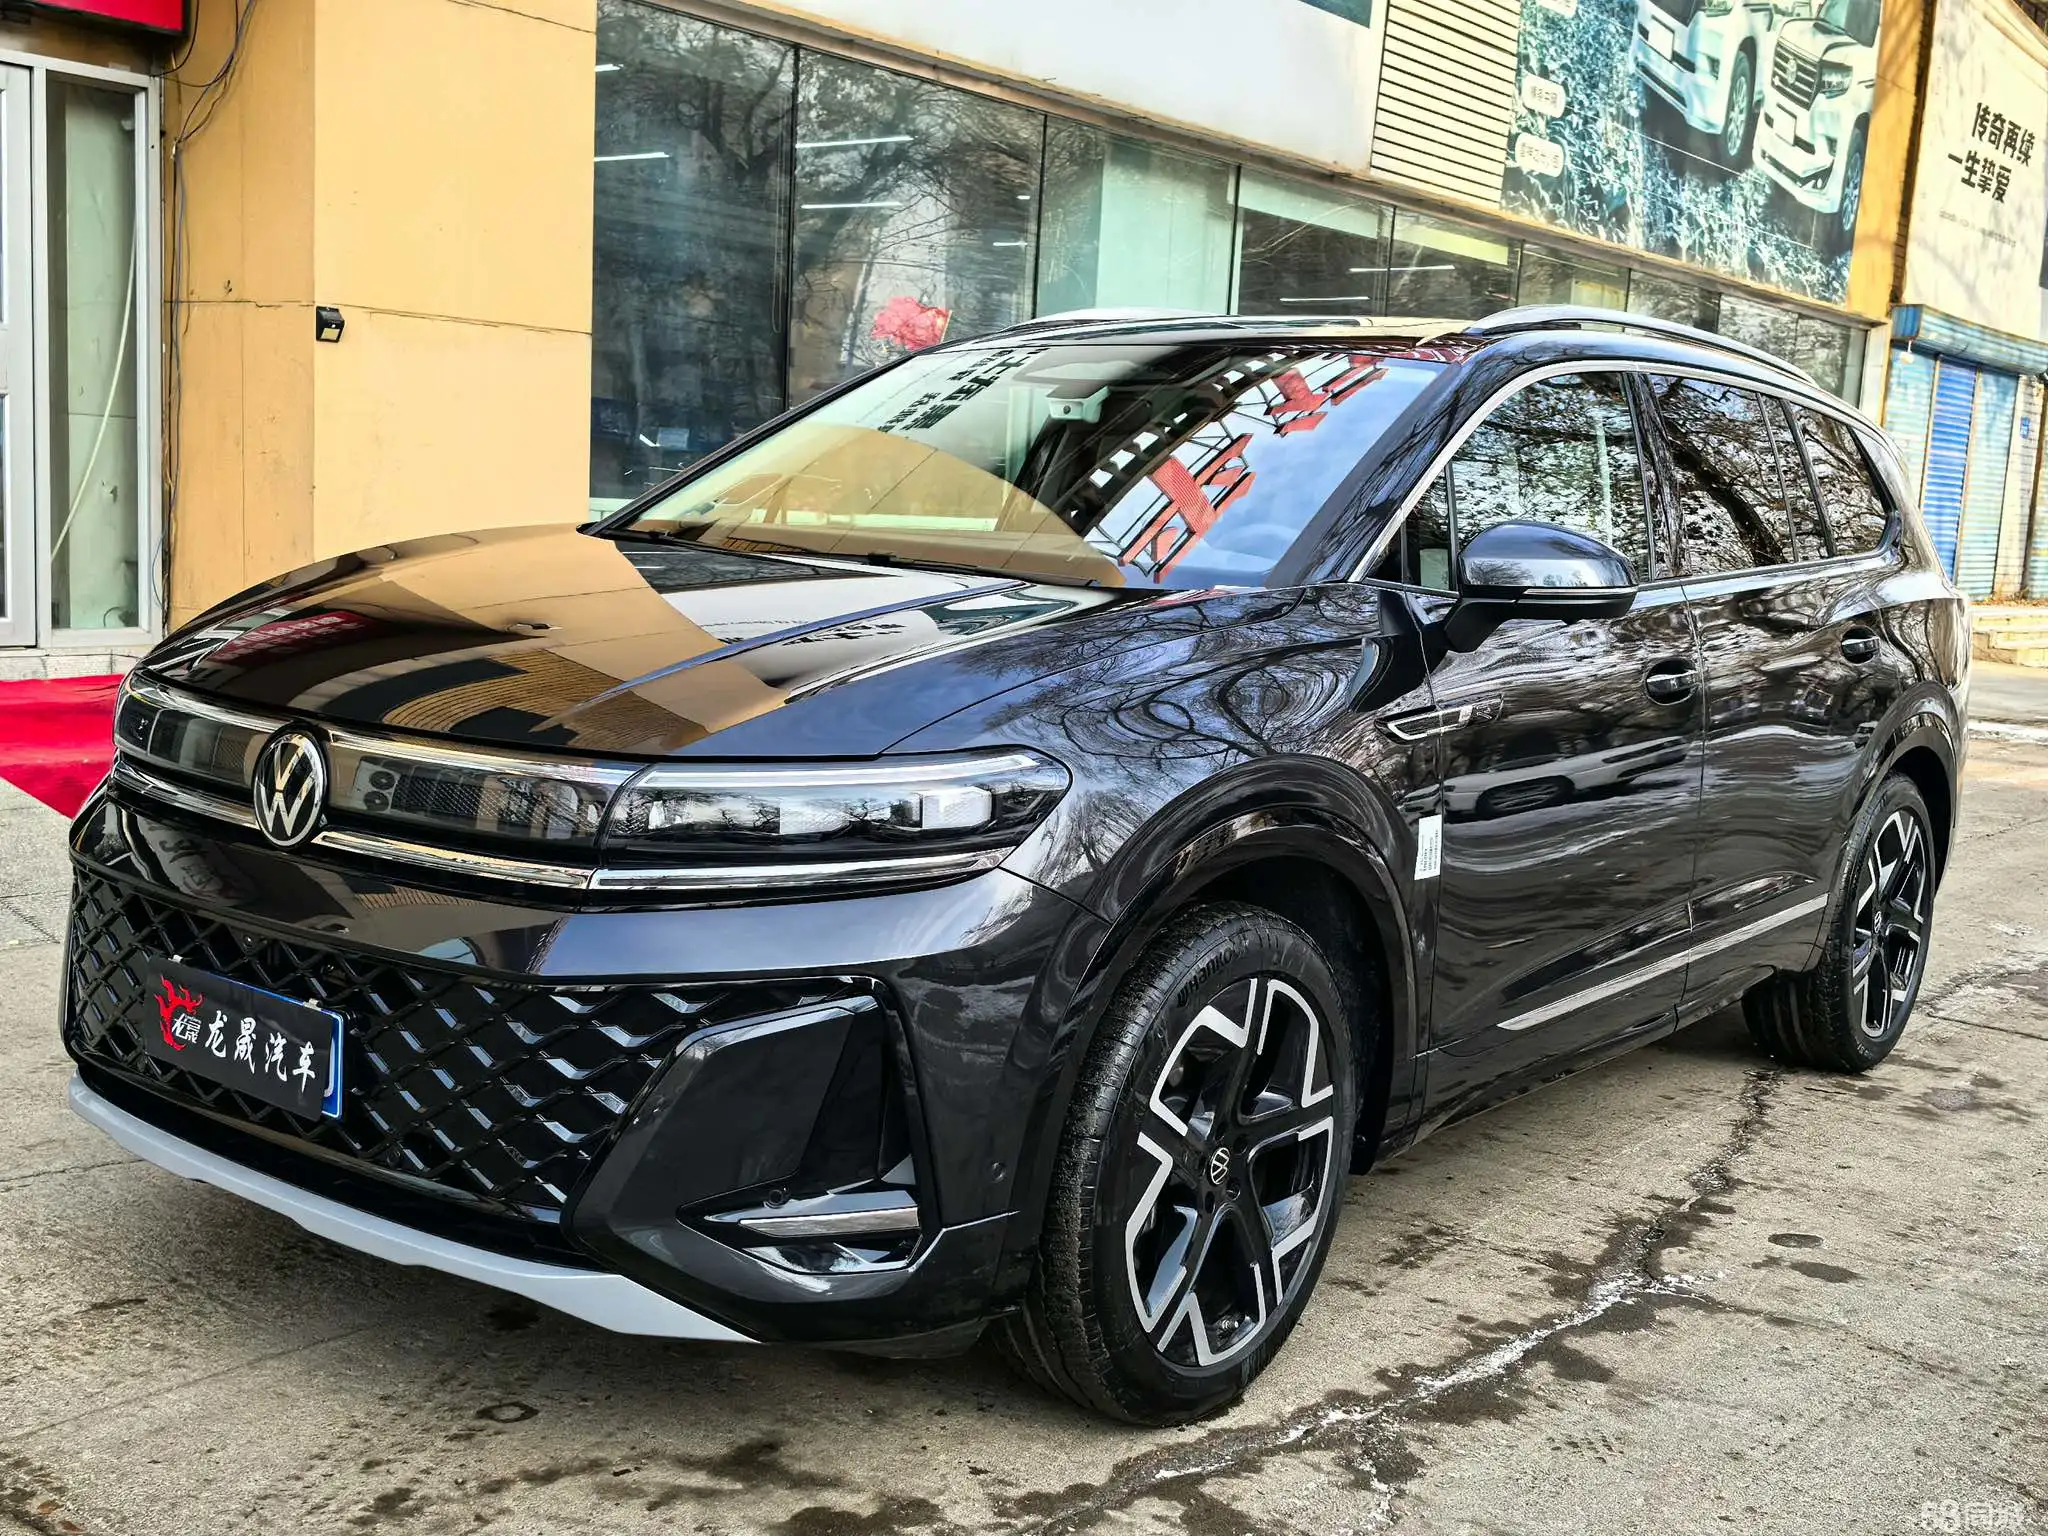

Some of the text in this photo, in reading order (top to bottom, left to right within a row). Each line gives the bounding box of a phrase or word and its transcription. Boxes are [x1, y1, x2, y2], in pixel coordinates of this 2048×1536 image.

[1971, 102, 2035, 167] 传奇再续
[1948, 150, 2012, 203] 一生挚爱
[205, 1010, 316, 1093] 龙晟汽车
